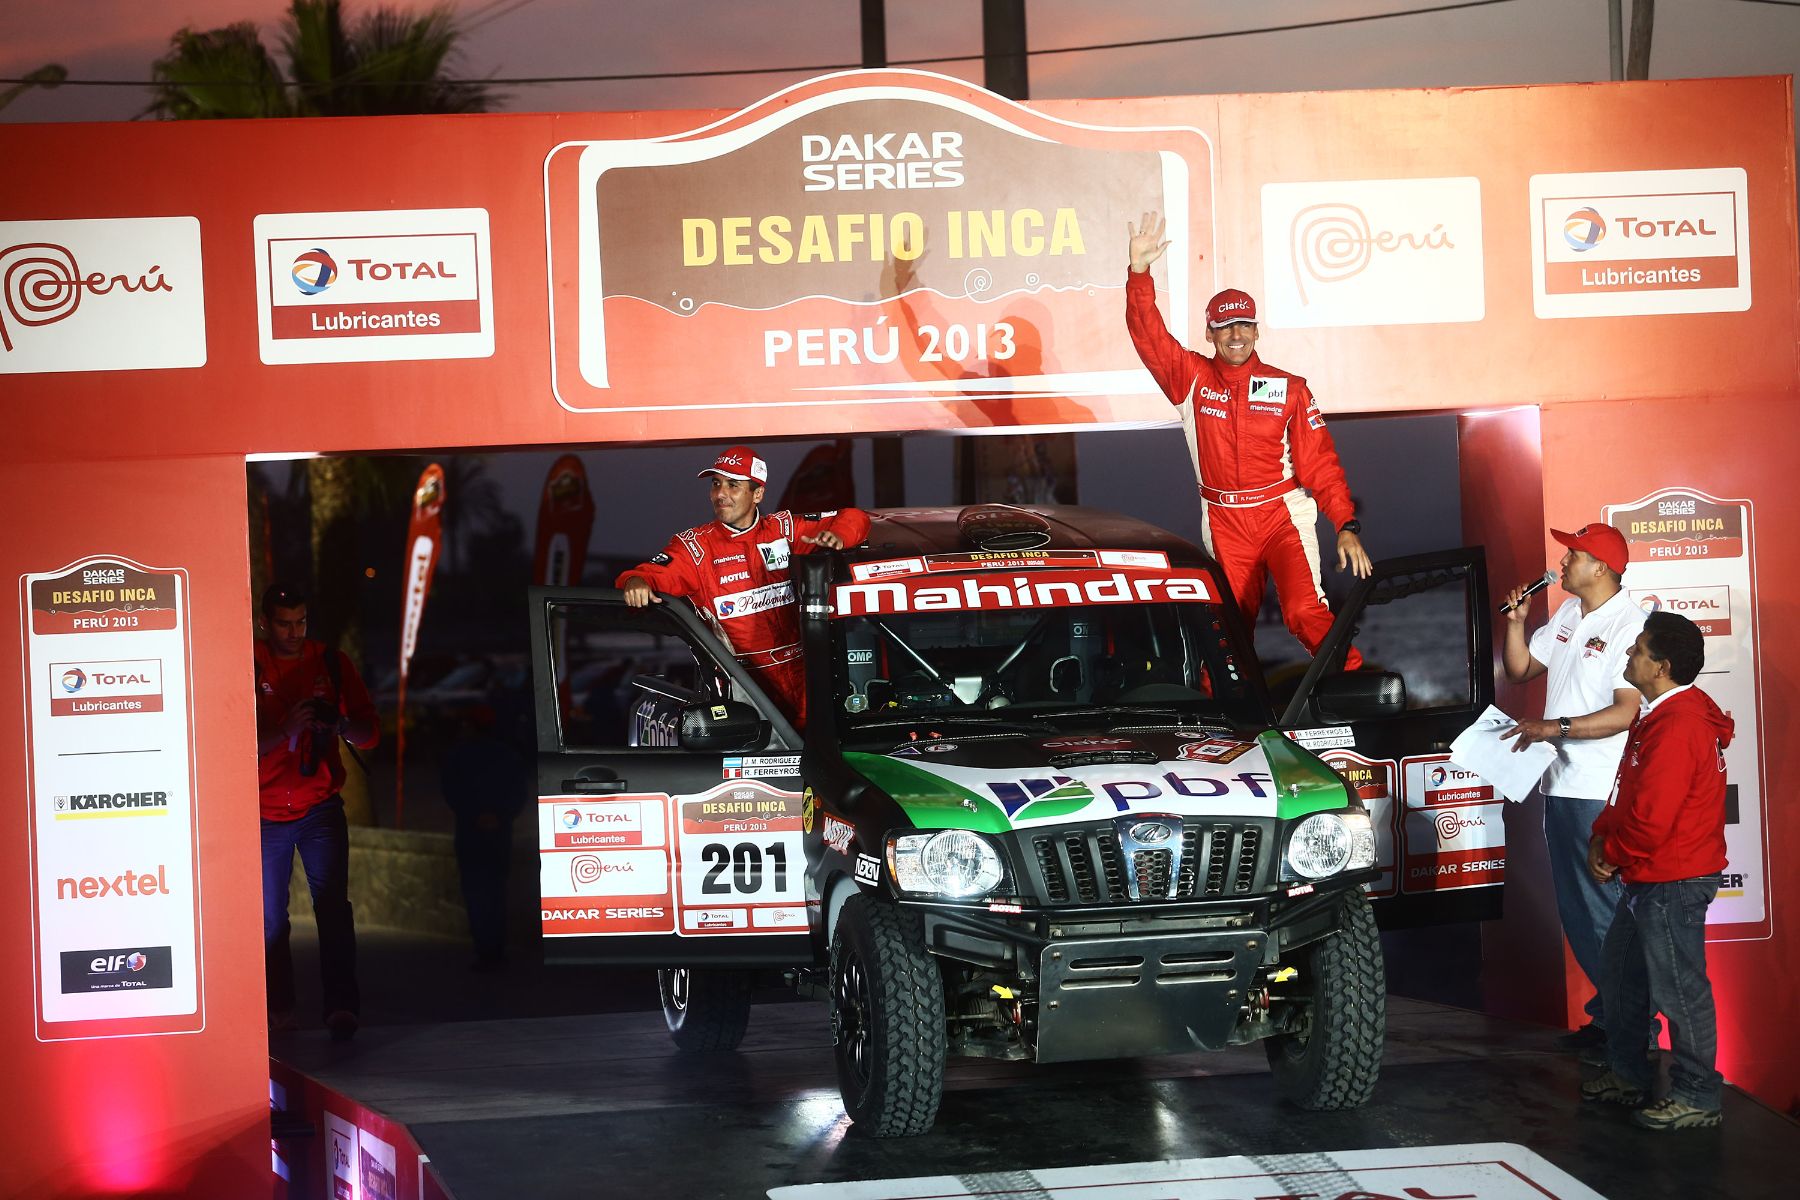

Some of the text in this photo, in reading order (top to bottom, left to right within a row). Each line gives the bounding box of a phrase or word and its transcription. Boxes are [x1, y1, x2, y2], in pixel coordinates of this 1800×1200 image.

[802, 131, 963, 162] DAKAR
[803, 161, 964, 191] SERIES
[682, 207, 1086, 267] DESAFIO INCA
[1581, 265, 1701, 288] Lubricantes
[1218, 301, 1246, 313] Claro
[311, 311, 441, 332] Lubricantes
[764, 315, 1016, 367] PERÚ 2013
[1200, 386, 1229, 403] Claro
[1268, 390, 1284, 399] pbf
[1200, 405, 1227, 419] MOTUL
[1658, 500, 1695, 509] DAKAR
[1658, 507, 1695, 516] SERIES
[1631, 518, 1724, 534] DESAFIO INCA
[970, 552, 1018, 560] DESAFIO
[1649, 544, 1708, 557] PERÚ 2013
[776, 551, 791, 565] pbf
[83, 569, 124, 578] DAKAR
[720, 571, 750, 584] MOTUL
[83, 577, 125, 585] SERIES
[53, 588, 156, 605] DESAFIO INCA
[73, 615, 139, 629] PERÚ 2013
[848, 652, 872, 662] OMP
[72, 700, 142, 712] Lubricantes
[753, 768, 800, 776] FERREYROS
[1348, 770, 1372, 781] INCA
[1450, 770, 1480, 780] TOTA
[1102, 771, 1271, 811] pbf
[1437, 790, 1481, 801] Lubricantes
[70, 791, 168, 810] KÄRCHER
[703, 801, 786, 814] DESAFIO INCA
[723, 822, 767, 832] PERÚ 2013
[570, 834, 626, 845] Lubricantes
[701, 842, 787, 895] 201
[1411, 859, 1505, 878] DAKAR SERIES
[57, 865, 169, 900] nextel
[541, 907, 664, 921] DAKAR SERIES
[91, 955, 126, 972] elf
